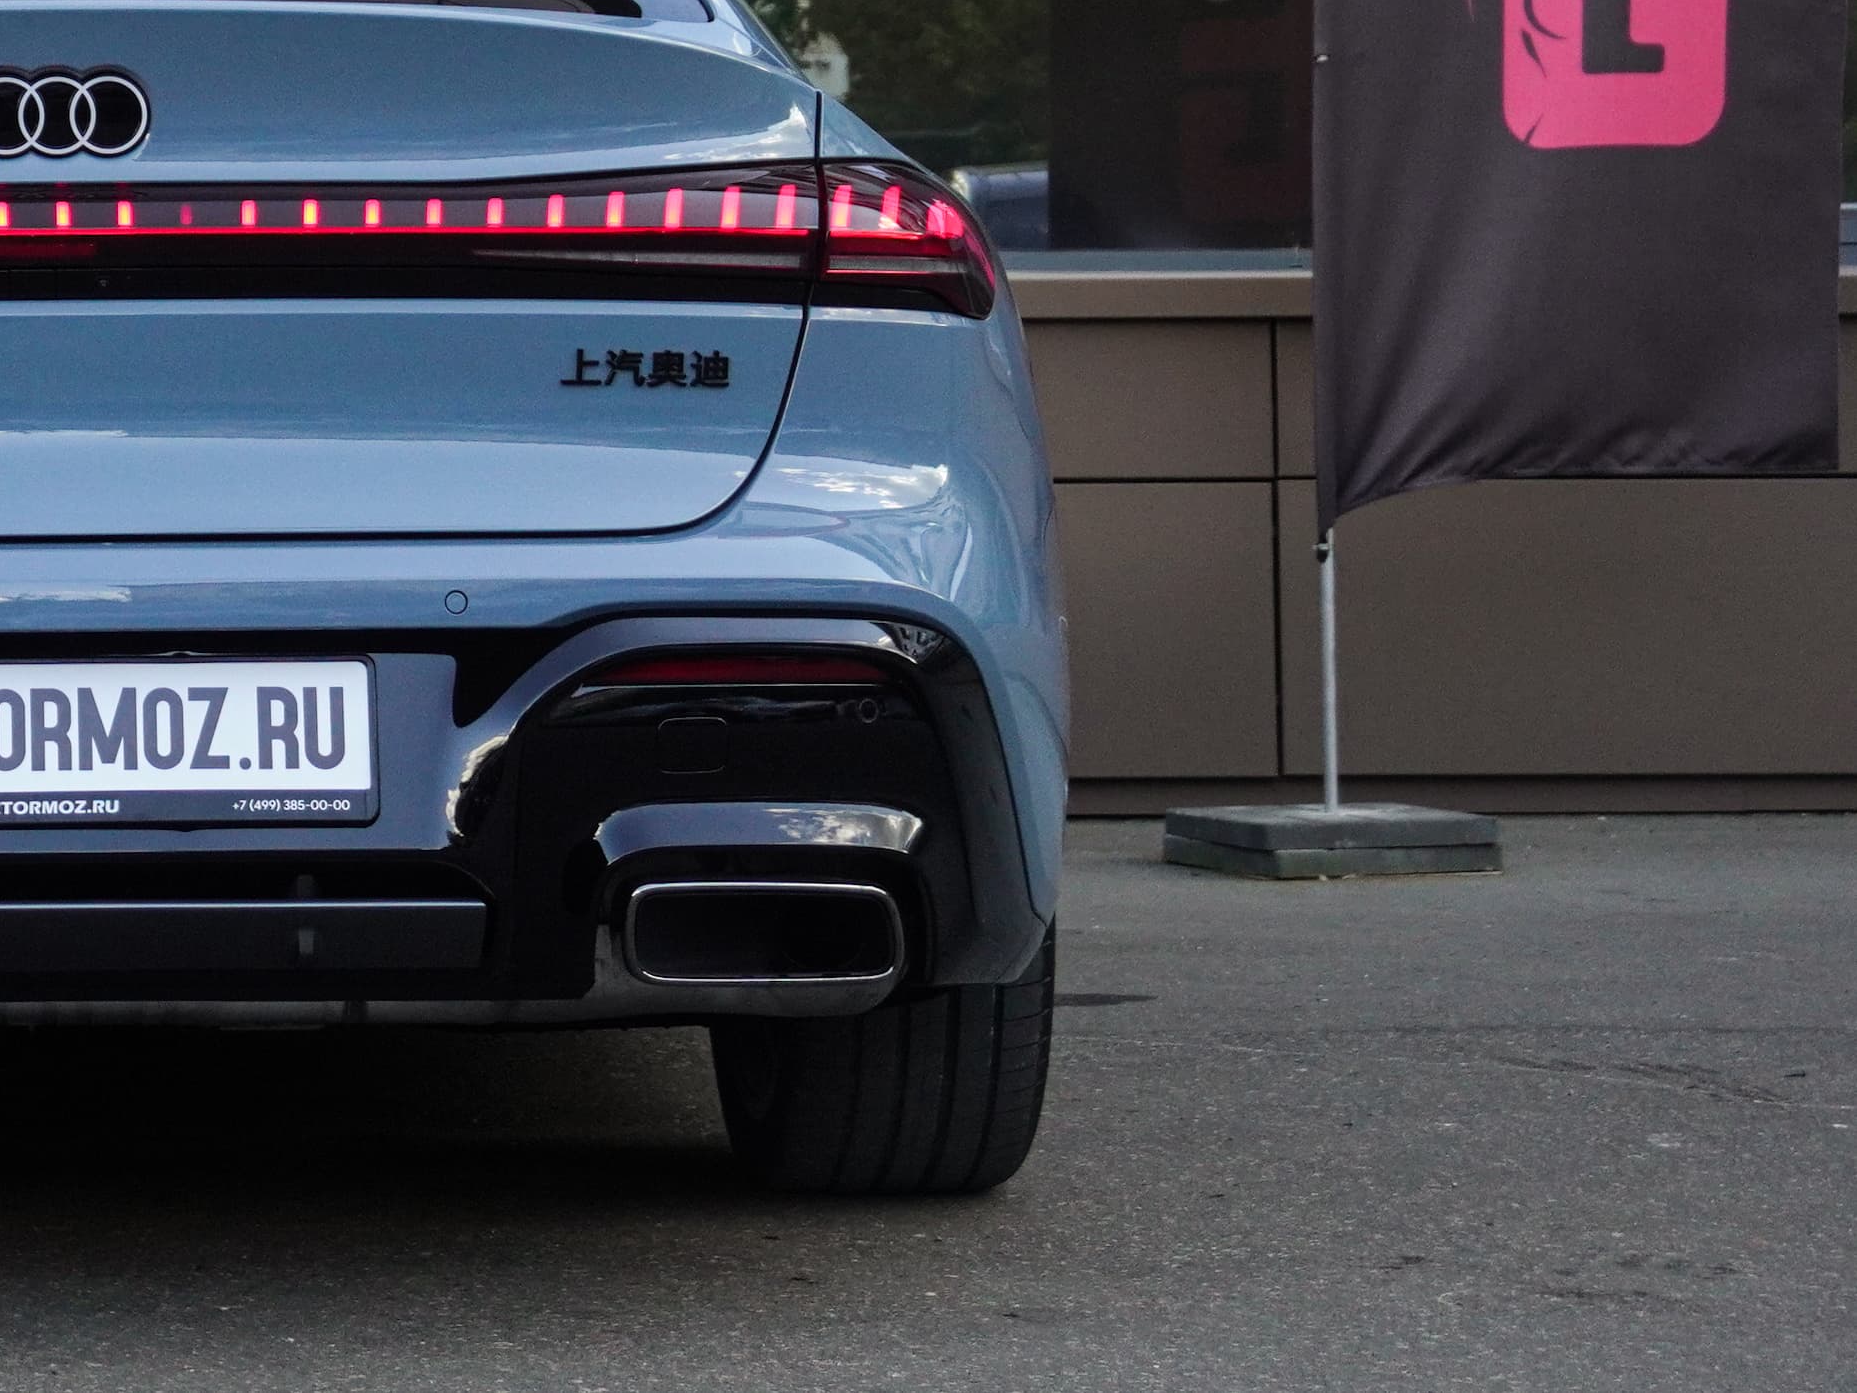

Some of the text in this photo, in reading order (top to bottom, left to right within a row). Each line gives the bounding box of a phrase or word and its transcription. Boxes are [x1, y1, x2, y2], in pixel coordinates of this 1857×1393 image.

[560, 349, 730, 387] 上汽奥迪
[232, 799, 351, 812] +7 (499) 385-00-00
